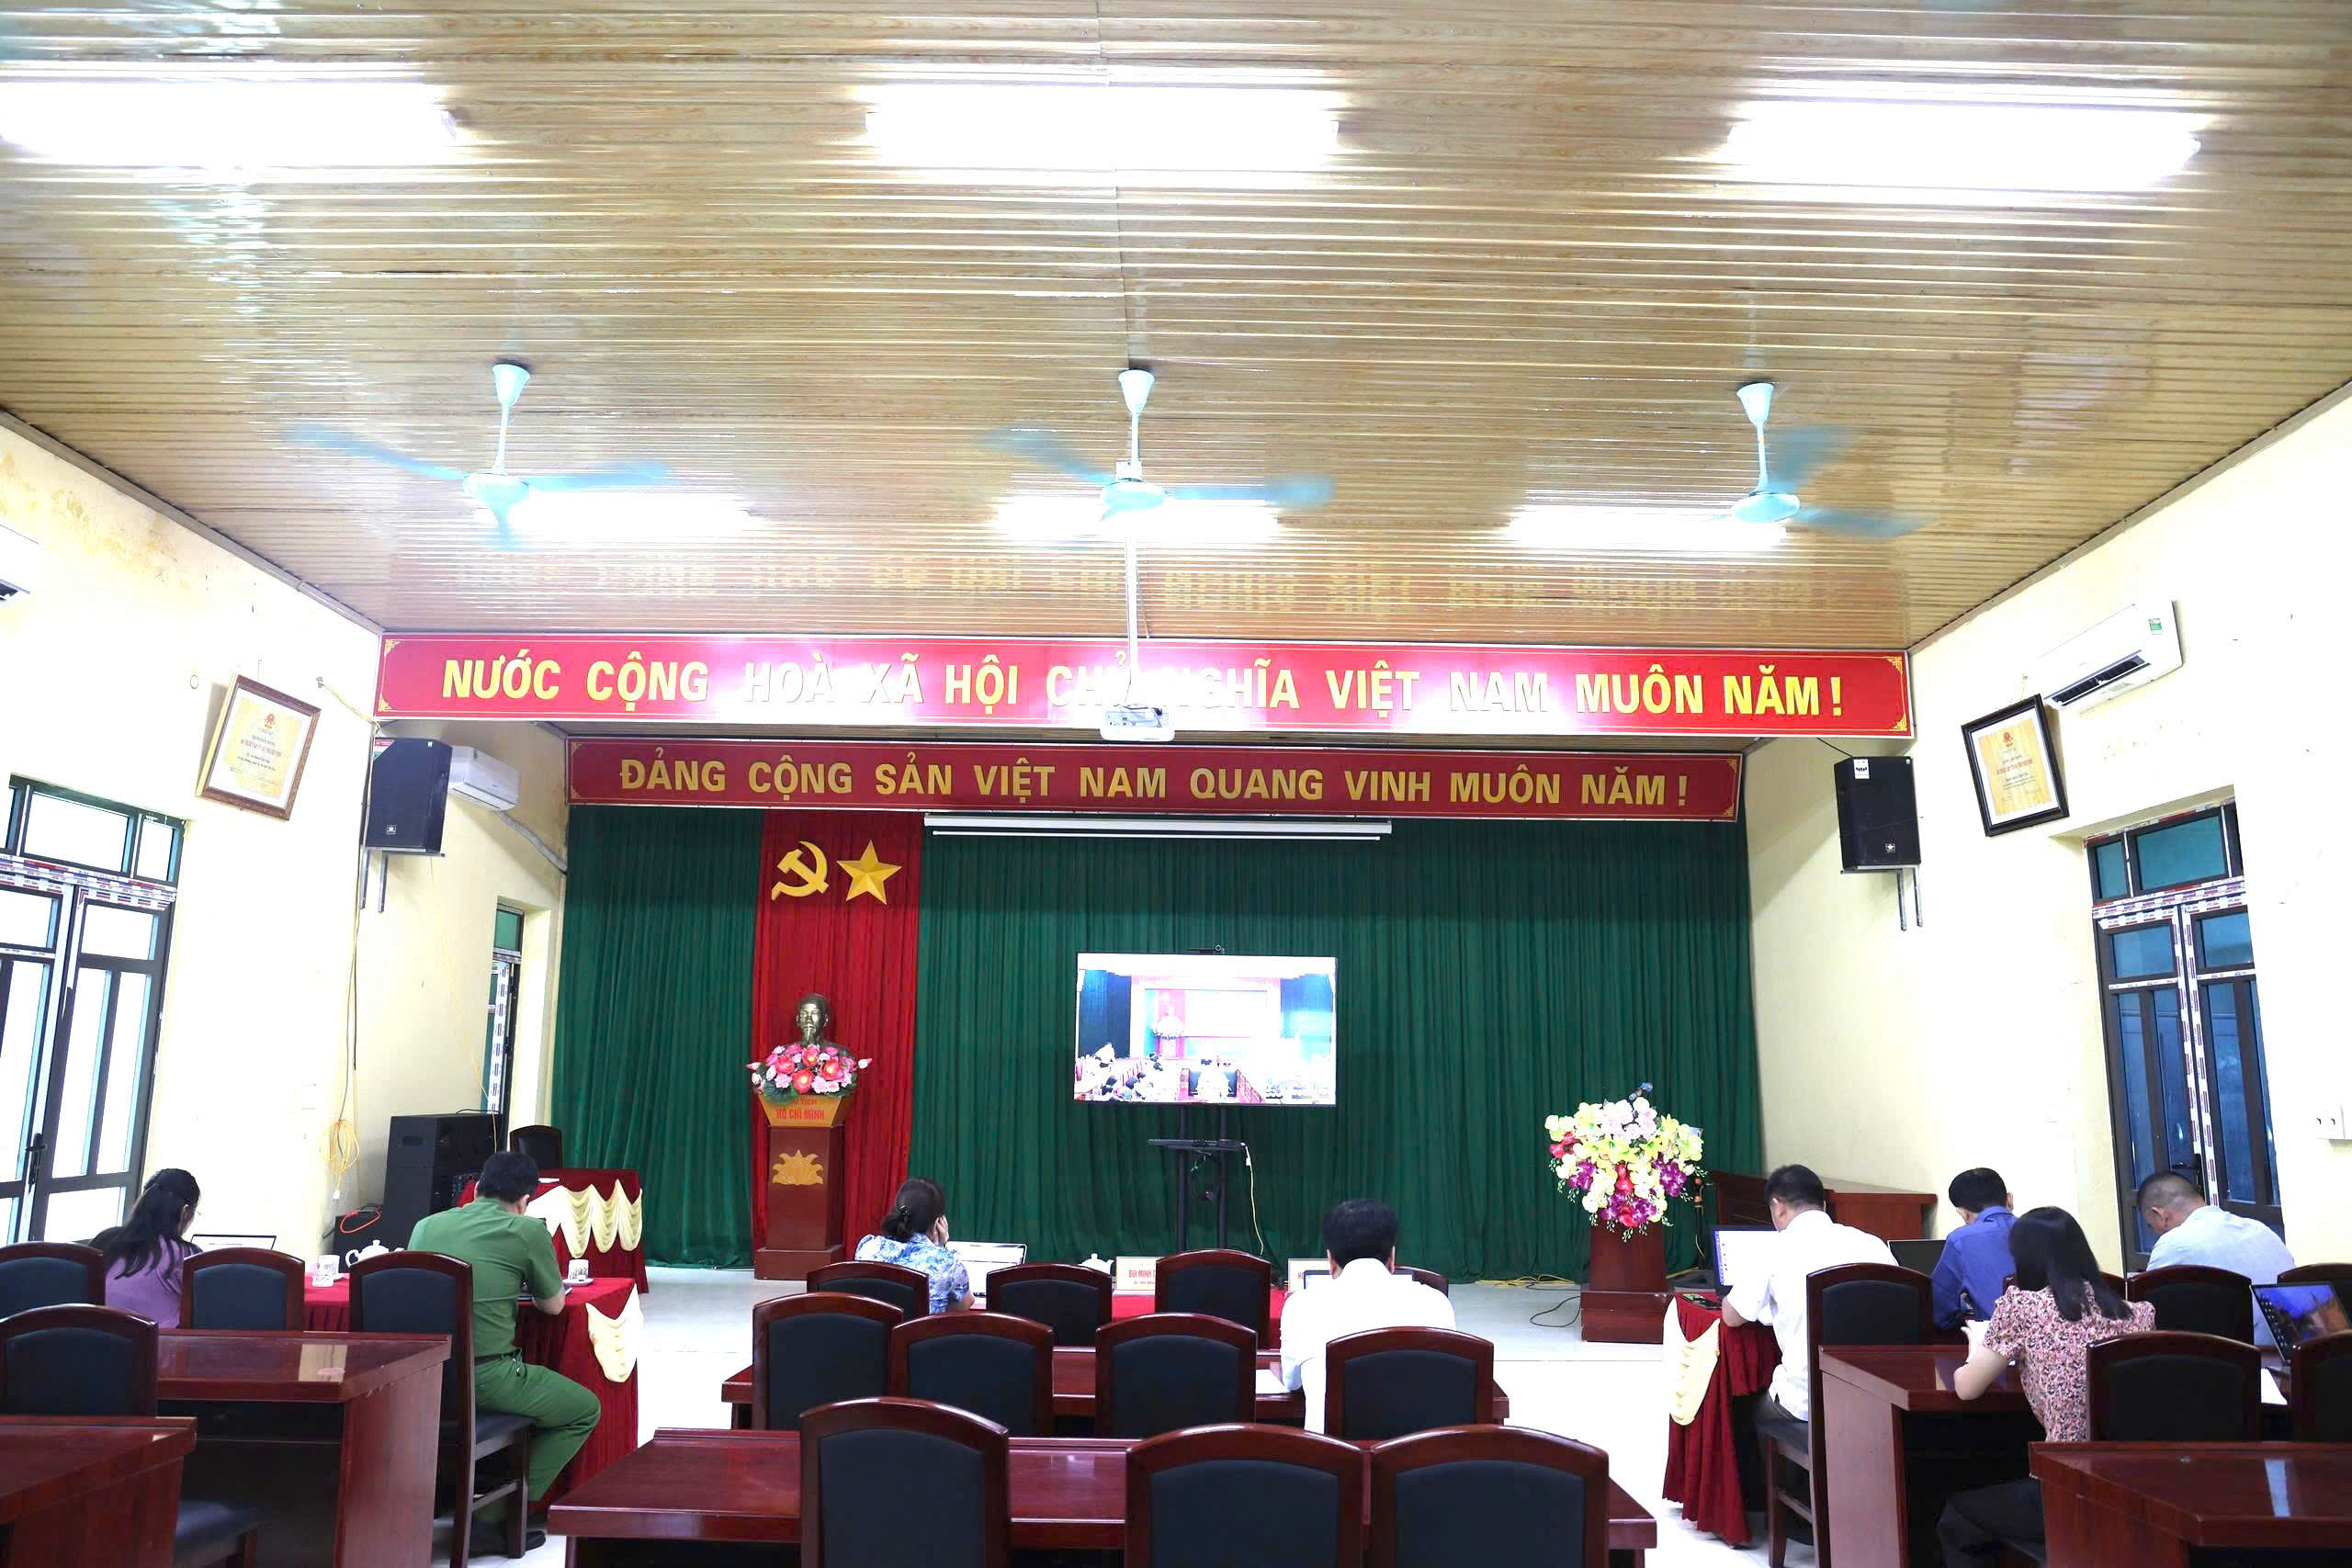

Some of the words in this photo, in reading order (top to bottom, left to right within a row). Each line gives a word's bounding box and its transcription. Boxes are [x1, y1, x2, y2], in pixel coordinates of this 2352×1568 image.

[441, 649, 561, 701] NƯỚC
[586, 650, 708, 712] CỘNG
[744, 652, 834, 704] HOÀ
[861, 652, 925, 705] XÃ
[944, 653, 1019, 715] HỘI
[1325, 660, 1420, 719] VIỆT
[1449, 671, 1548, 712] NAM
[1575, 663, 1703, 714] MUÔN
[620, 746, 727, 792] ĐẢNG
[748, 754, 853, 801] CỘNG
[875, 751, 952, 795] SẢN
[973, 757, 1056, 804] VIỆT
[1080, 767, 1166, 798] NAM
[1190, 767, 1324, 801] QUANG
[1344, 771, 1430, 802] VINH
[1450, 763, 1560, 804] MUÔN
